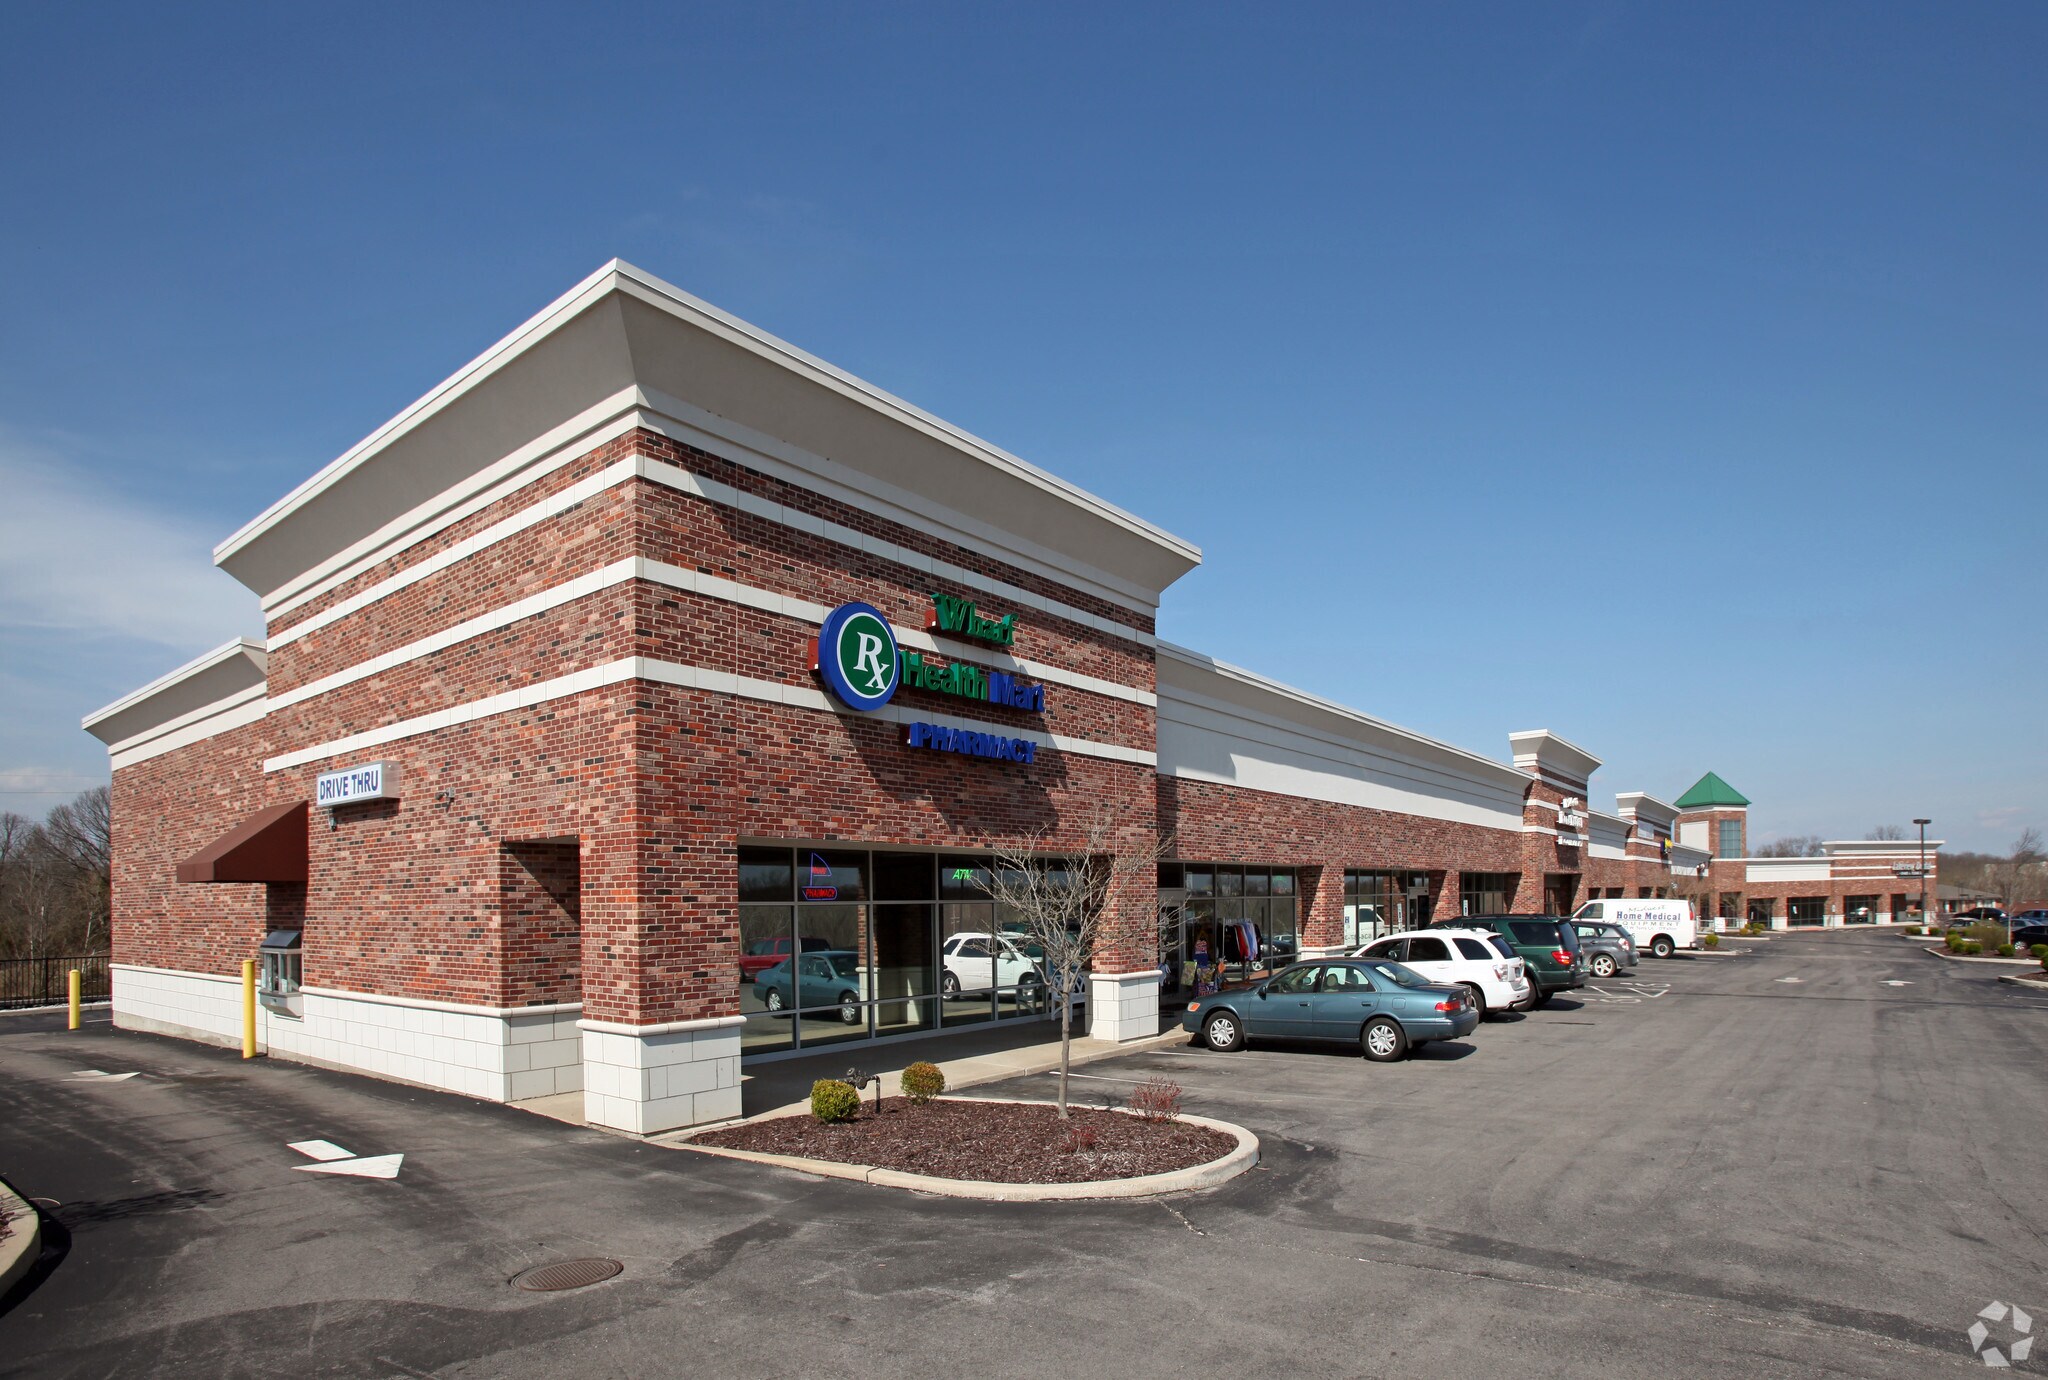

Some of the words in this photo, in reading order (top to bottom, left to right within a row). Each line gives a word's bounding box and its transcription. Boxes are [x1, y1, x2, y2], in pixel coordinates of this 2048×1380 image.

[931, 593, 1018, 645] Wharf
[899, 650, 988, 700] Health
[989, 671, 1045, 712] Mart
[910, 722, 1037, 764] PHARMACY
[320, 776, 349, 800] DRIVE
[351, 770, 379, 795] THRU
[1616, 910, 1642, 919] Home
[1645, 912, 1681, 920] Medical
